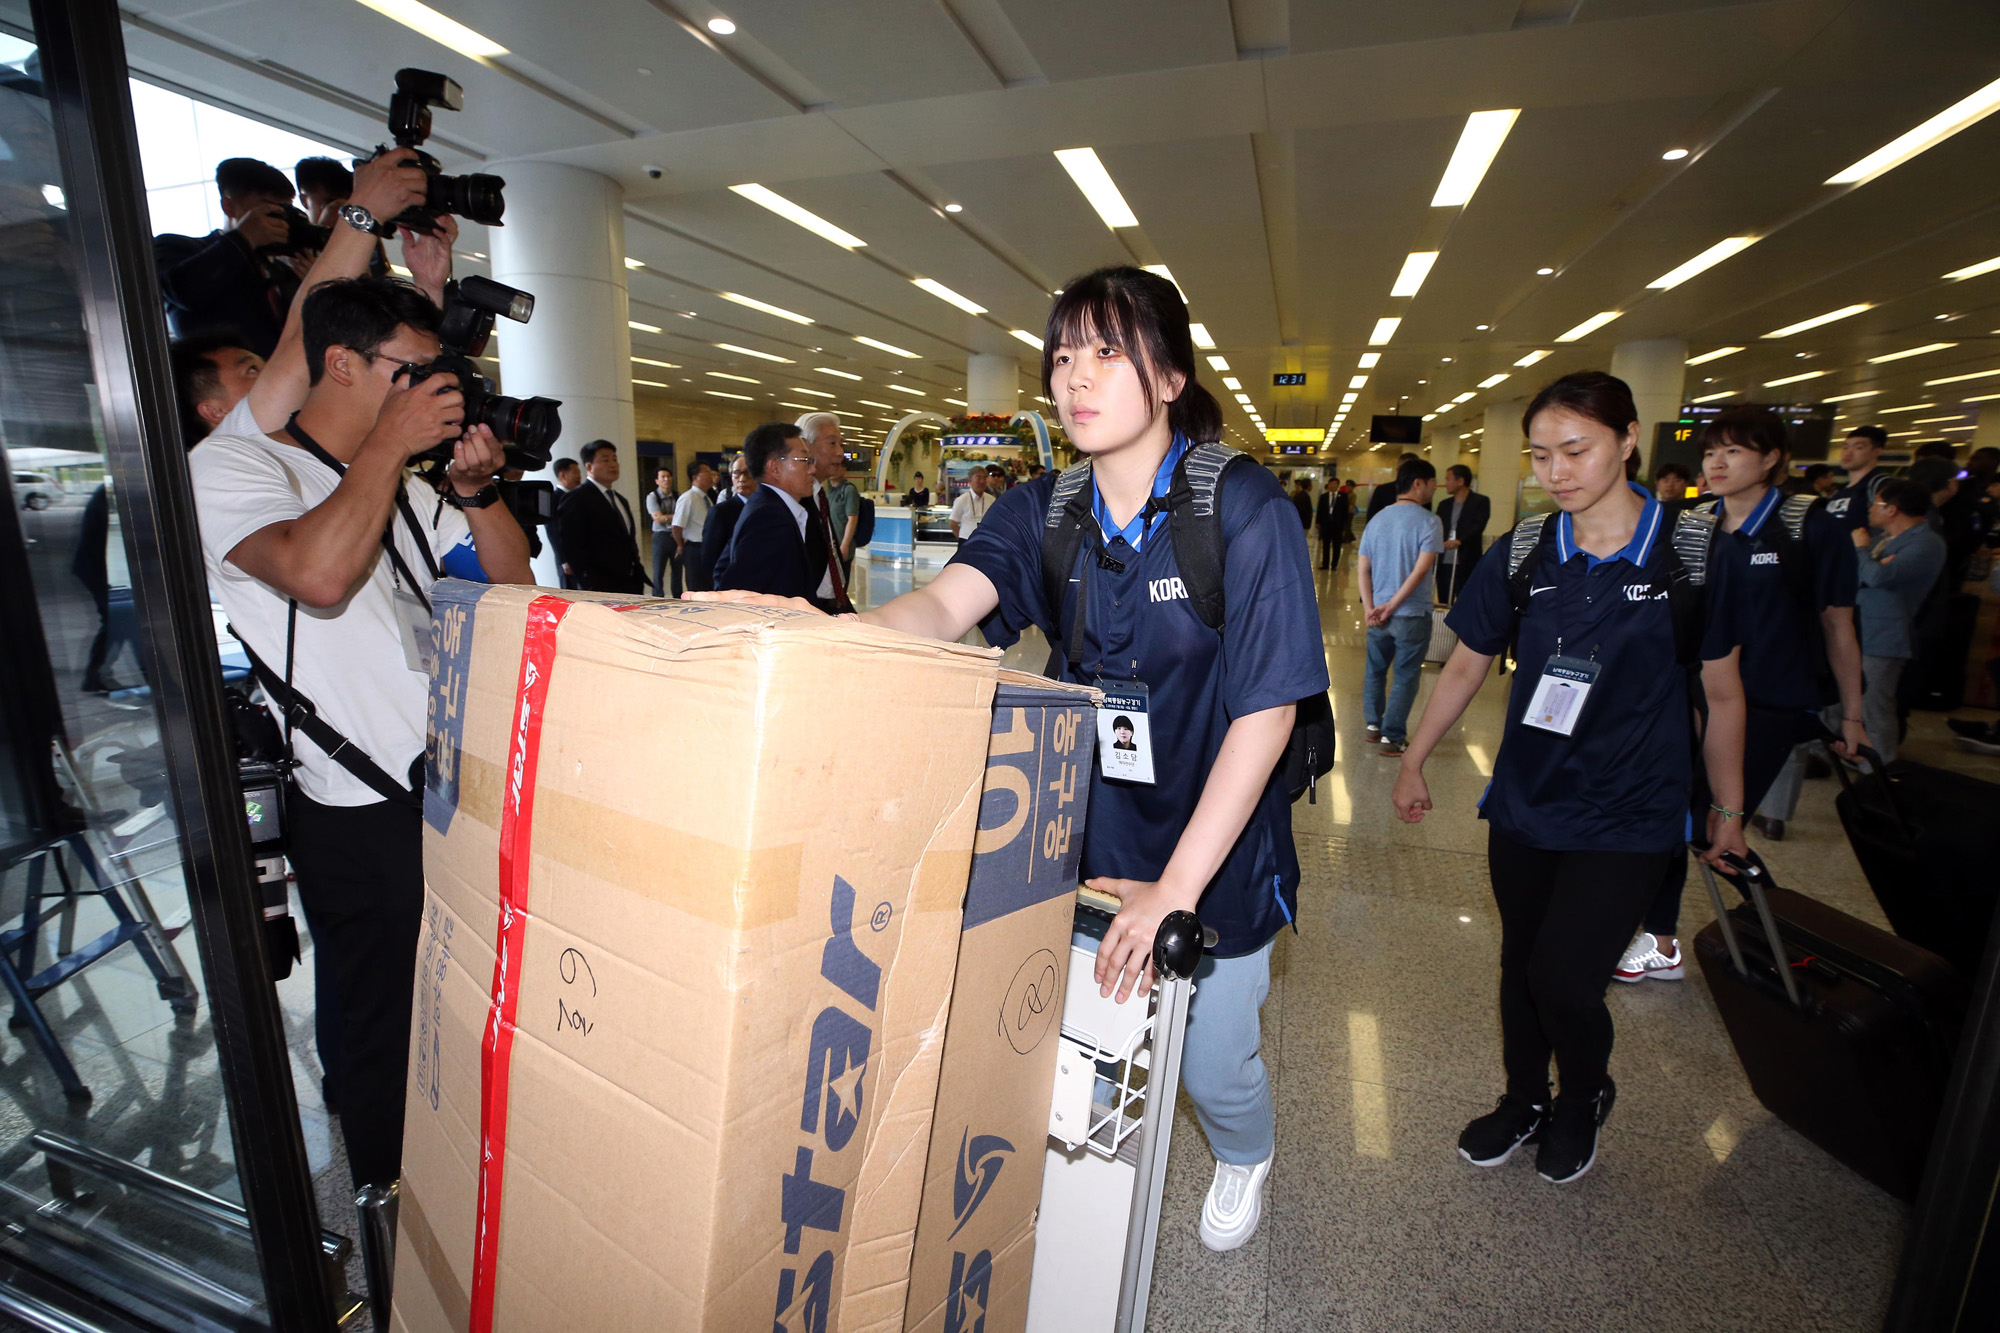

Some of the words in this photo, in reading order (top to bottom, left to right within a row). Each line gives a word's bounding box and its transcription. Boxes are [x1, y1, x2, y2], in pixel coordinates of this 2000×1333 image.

[1674, 429, 1692, 441] 1F
[1750, 552, 1780, 566] KORE
[1149, 577, 1189, 603] KOR
[1622, 584, 1669, 601] KOA
[437, 604, 467, 783] 농구공
[512, 694, 531, 817] star
[1044, 708, 1082, 861] 농구공
